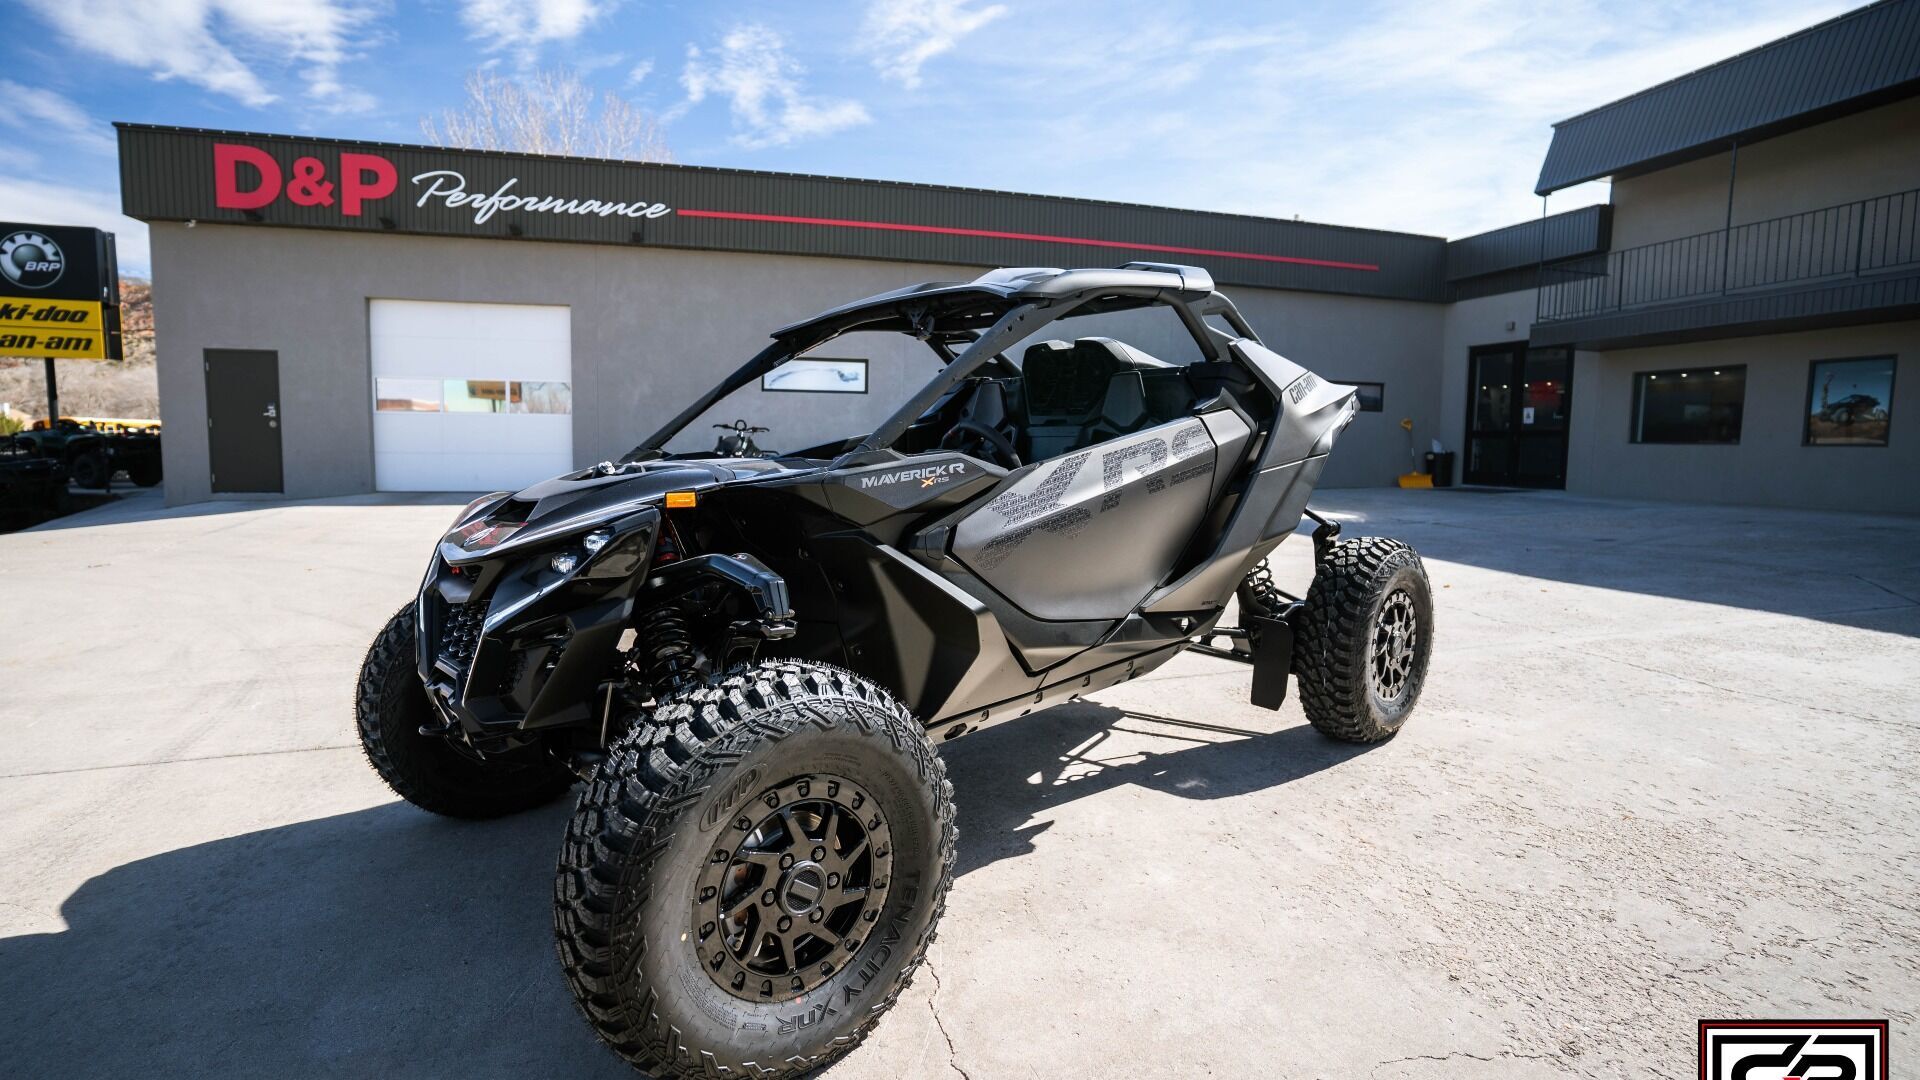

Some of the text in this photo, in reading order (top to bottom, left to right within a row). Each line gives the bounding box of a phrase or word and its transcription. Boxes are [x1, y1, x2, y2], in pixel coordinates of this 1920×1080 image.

[214, 143, 672, 225] D&P Performance
[24, 261, 61, 272] BRP
[0, 303, 88, 323] ki-doo
[0, 334, 93, 351] an-am
[861, 462, 966, 489] MAVERICK R
[842, 870, 921, 1006] TENACITY
